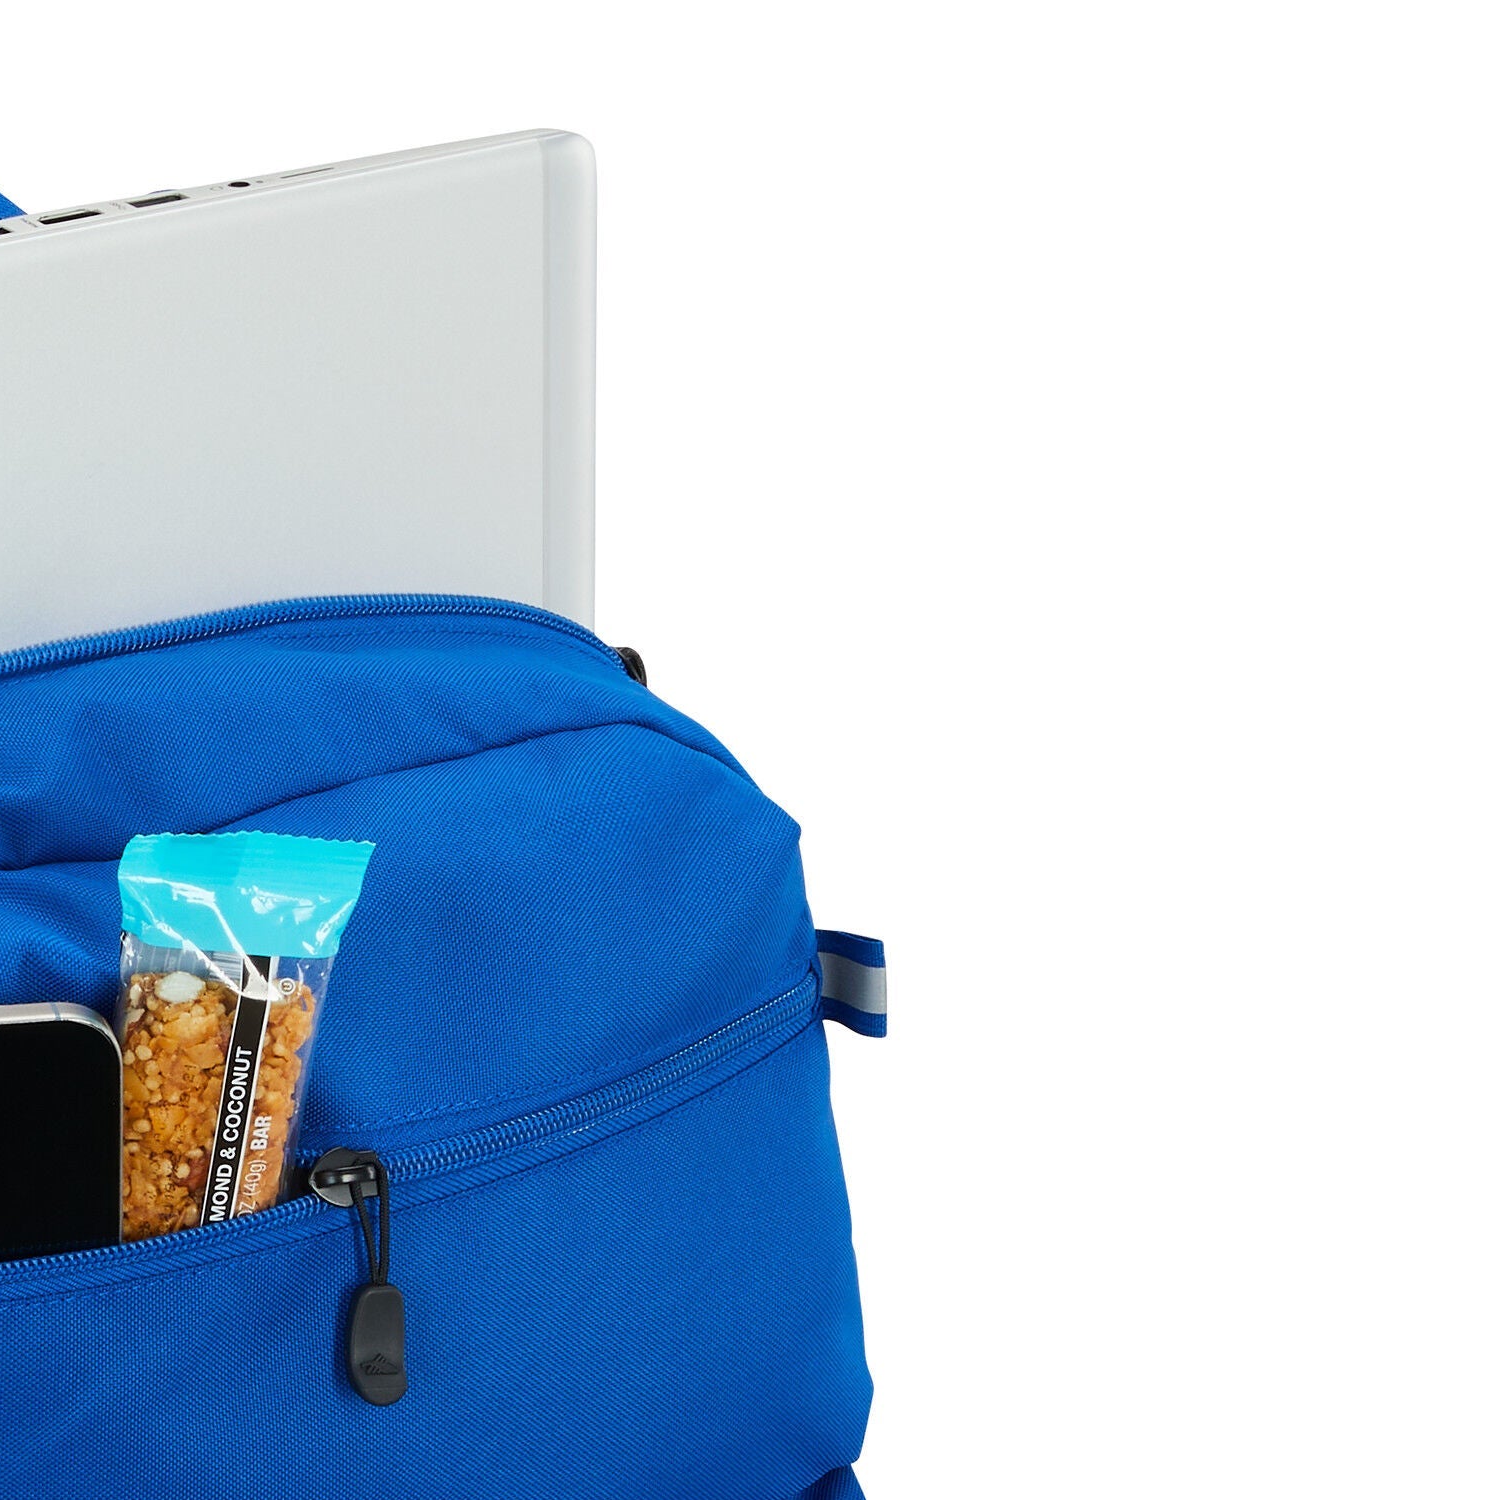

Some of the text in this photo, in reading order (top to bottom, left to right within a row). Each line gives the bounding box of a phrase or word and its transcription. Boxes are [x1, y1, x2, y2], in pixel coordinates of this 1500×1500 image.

[209, 1046, 252, 1222] MOND & COCONUT
[250, 1115, 272, 1150] BAR
[243, 1160, 268, 1196] (40g)
